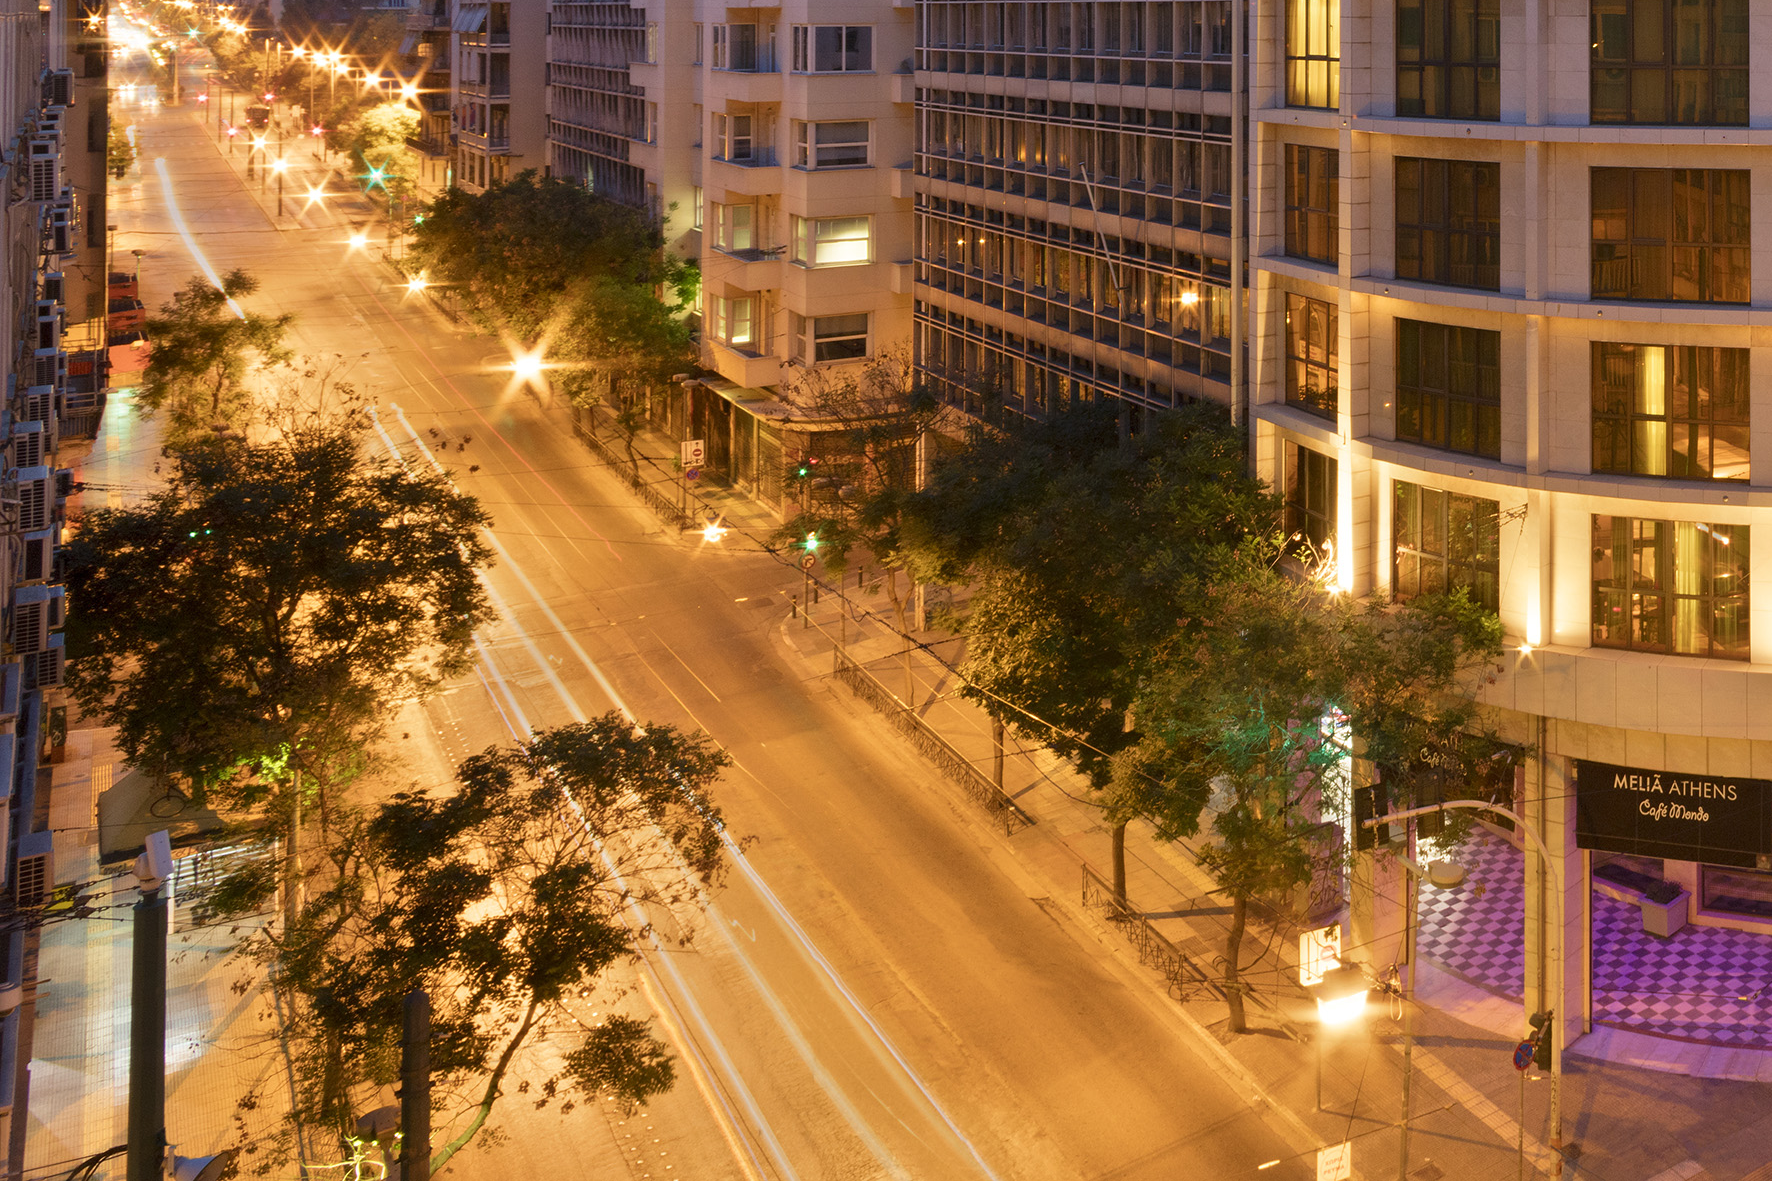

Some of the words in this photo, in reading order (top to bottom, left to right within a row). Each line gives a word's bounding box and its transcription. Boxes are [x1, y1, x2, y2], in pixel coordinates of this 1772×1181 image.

[1613, 773, 1664, 794] MELIÃ
[1668, 780, 1738, 801] ATHENS
[1639, 798, 1668, 821] Café
[1668, 802, 1710, 822] Mondo
